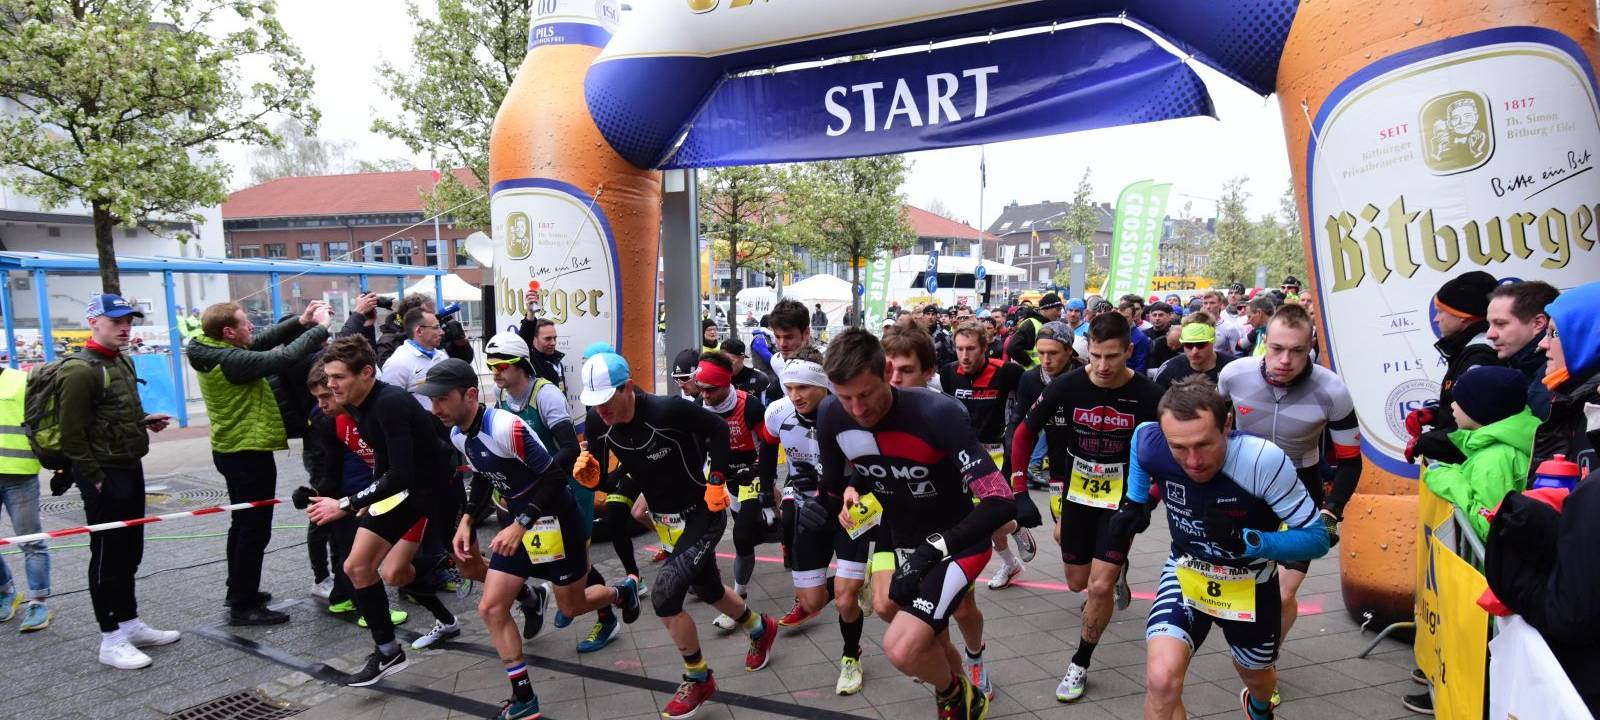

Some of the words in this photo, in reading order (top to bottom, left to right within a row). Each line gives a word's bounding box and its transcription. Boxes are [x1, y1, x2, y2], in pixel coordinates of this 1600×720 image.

[536, 26, 554, 39] PILS
[823, 64, 999, 138] START
[1503, 98, 1535, 111] 1817
[1526, 112, 1558, 124] Simon
[1380, 123, 1409, 140] SEIT
[1507, 125, 1547, 139] Bitburg
[1362, 140, 1412, 161] Bitburger
[1342, 152, 1414, 179] Privatbrauerei
[1491, 175, 1535, 197] Bitte
[1543, 166, 1565, 180] ein
[1567, 150, 1592, 170] Bit
[1390, 318, 1414, 328] Alk.
[1383, 358, 1423, 373] PILS
[1078, 411, 1129, 427] Alpecin
[1080, 477, 1111, 494] 734
[856, 502, 869, 515] 3
[531, 534, 541, 549] 4
[1229, 567, 1249, 576] MAN
[1207, 580, 1222, 598] 8
[1200, 596, 1232, 609] Anthony
